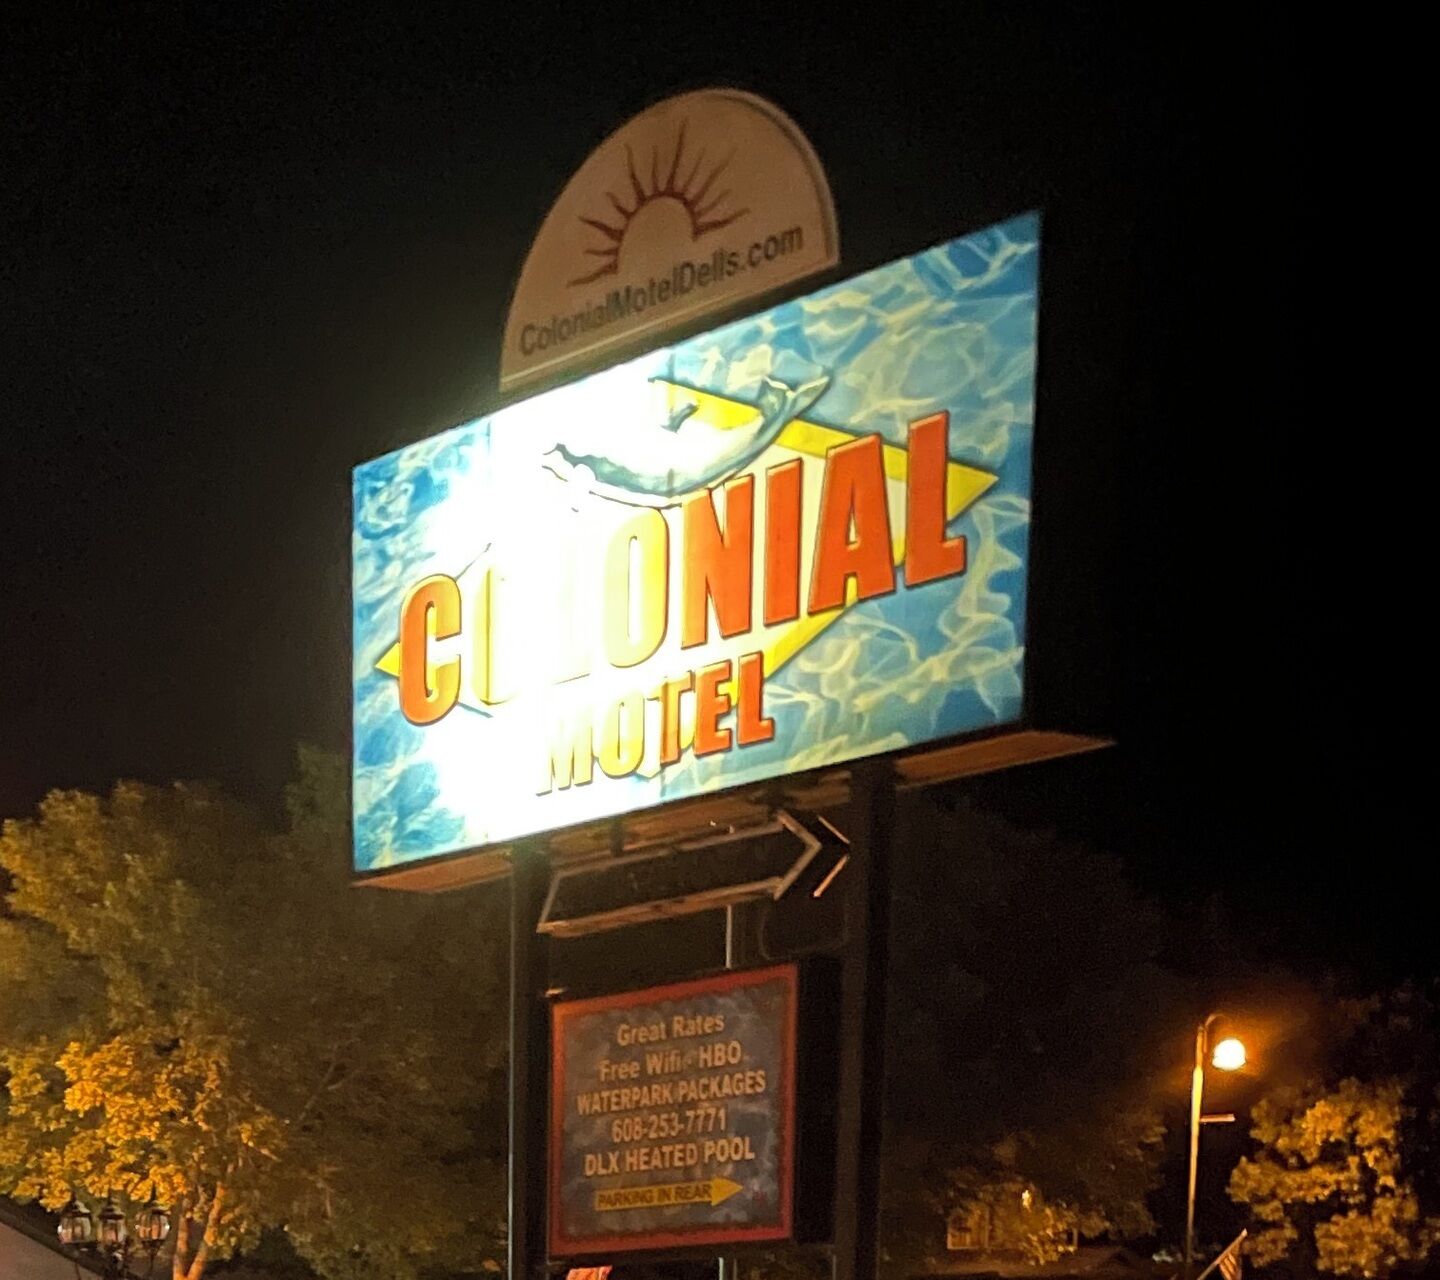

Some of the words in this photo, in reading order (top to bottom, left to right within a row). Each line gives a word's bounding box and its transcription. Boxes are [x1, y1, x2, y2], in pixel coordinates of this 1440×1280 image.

[519, 225, 804, 356] ColonialMotelDells.com
[536, 650, 775, 797] MOTEL
[616, 1021, 667, 1046] Great
[672, 1013, 726, 1038] Rates
[598, 1057, 641, 1082] Free
[645, 1049, 682, 1076] Wifi
[698, 1040, 742, 1069] HBO
[576, 1081, 674, 1116] WATERPARK
[678, 1069, 767, 1100] PACKAGES
[611, 1106, 727, 1143] 608-253-7771
[584, 1152, 620, 1177] DLX
[625, 1143, 699, 1171] HEATED
[703, 1136, 756, 1163] POOL
[597, 1188, 654, 1206] PARKING
[658, 1187, 674, 1203] IN
[675, 1184, 712, 1202] REAR
